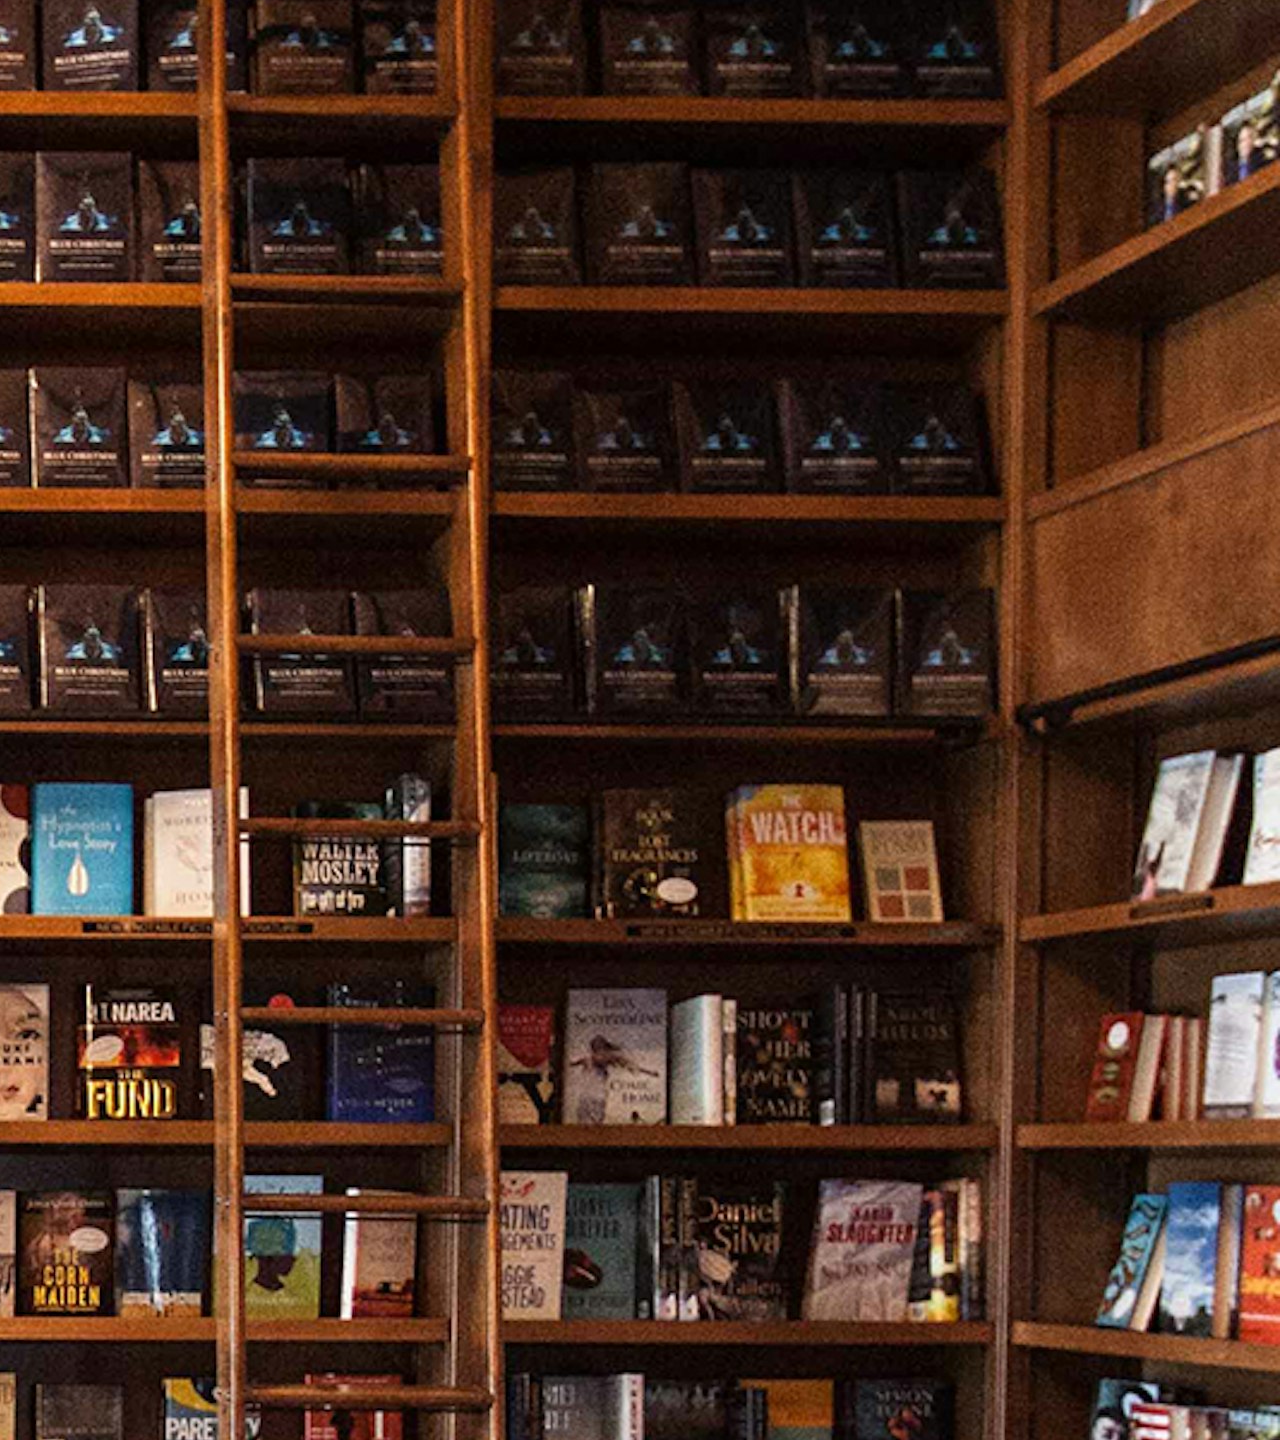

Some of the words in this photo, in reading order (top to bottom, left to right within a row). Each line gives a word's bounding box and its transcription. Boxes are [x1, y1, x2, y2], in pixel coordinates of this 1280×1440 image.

[41, 817, 121, 834] Hypnotist's
[751, 812, 834, 844] WATCH
[49, 835, 79, 849] Love
[83, 836, 117, 853] Story
[301, 862, 378, 885] MOSLEY
[111, 1003, 175, 1023] NAREA
[737, 1011, 812, 1029] SHOUT
[766, 1041, 811, 1059] HER
[88, 1082, 174, 1118] FUND
[747, 1099, 810, 1117] NAME
[699, 1197, 780, 1222] Daniel
[714, 1230, 780, 1256] Silva
[826, 1223, 915, 1245] SLAUGHTER
[54, 1250, 78, 1264] THE
[42, 1266, 89, 1286] CORN
[33, 1286, 102, 1308] MAIDEN
